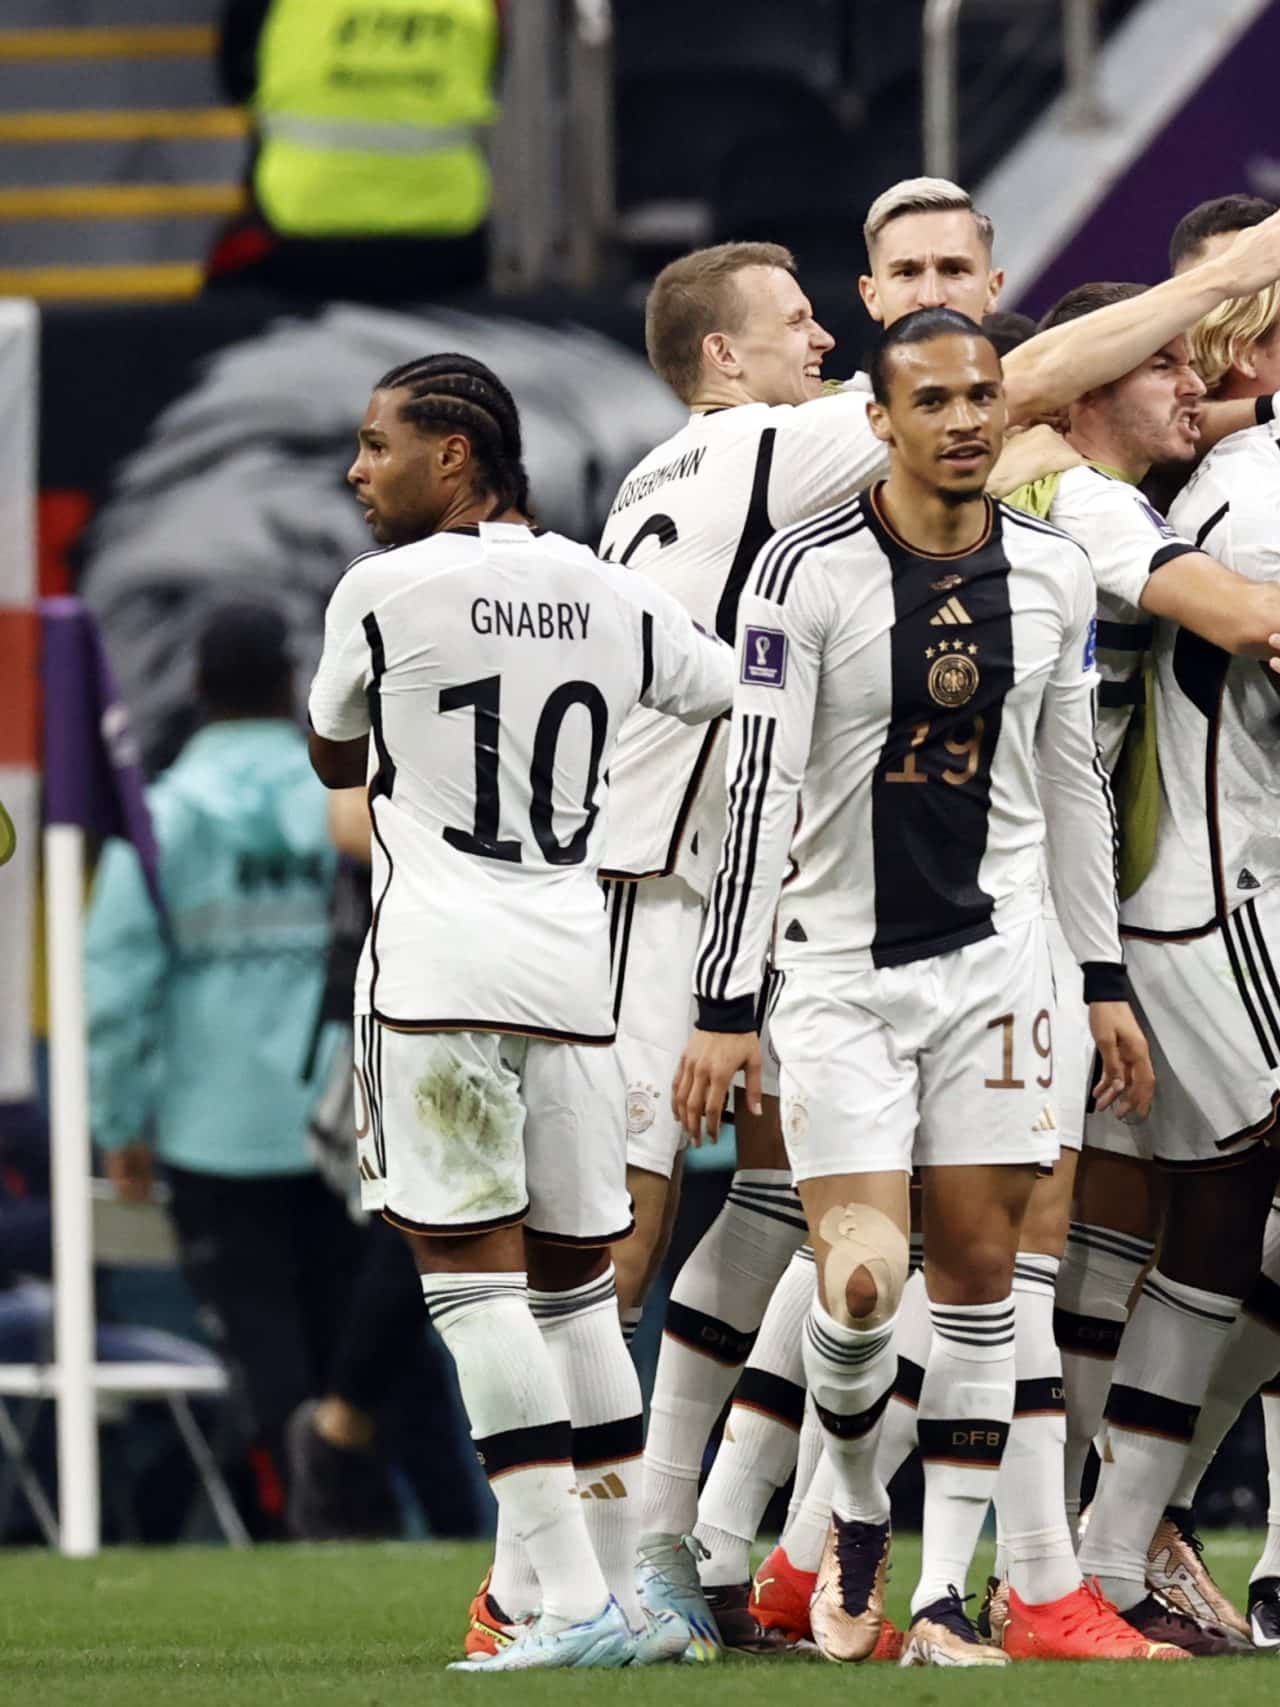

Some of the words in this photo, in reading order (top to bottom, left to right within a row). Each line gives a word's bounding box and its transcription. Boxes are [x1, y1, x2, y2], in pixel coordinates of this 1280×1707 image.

[471, 597, 590, 640] GNABRY
[439, 674, 608, 866] 10
[886, 718, 984, 785] 19
[984, 1008, 1053, 1089] 19
[951, 1431, 1000, 1447] DFB
